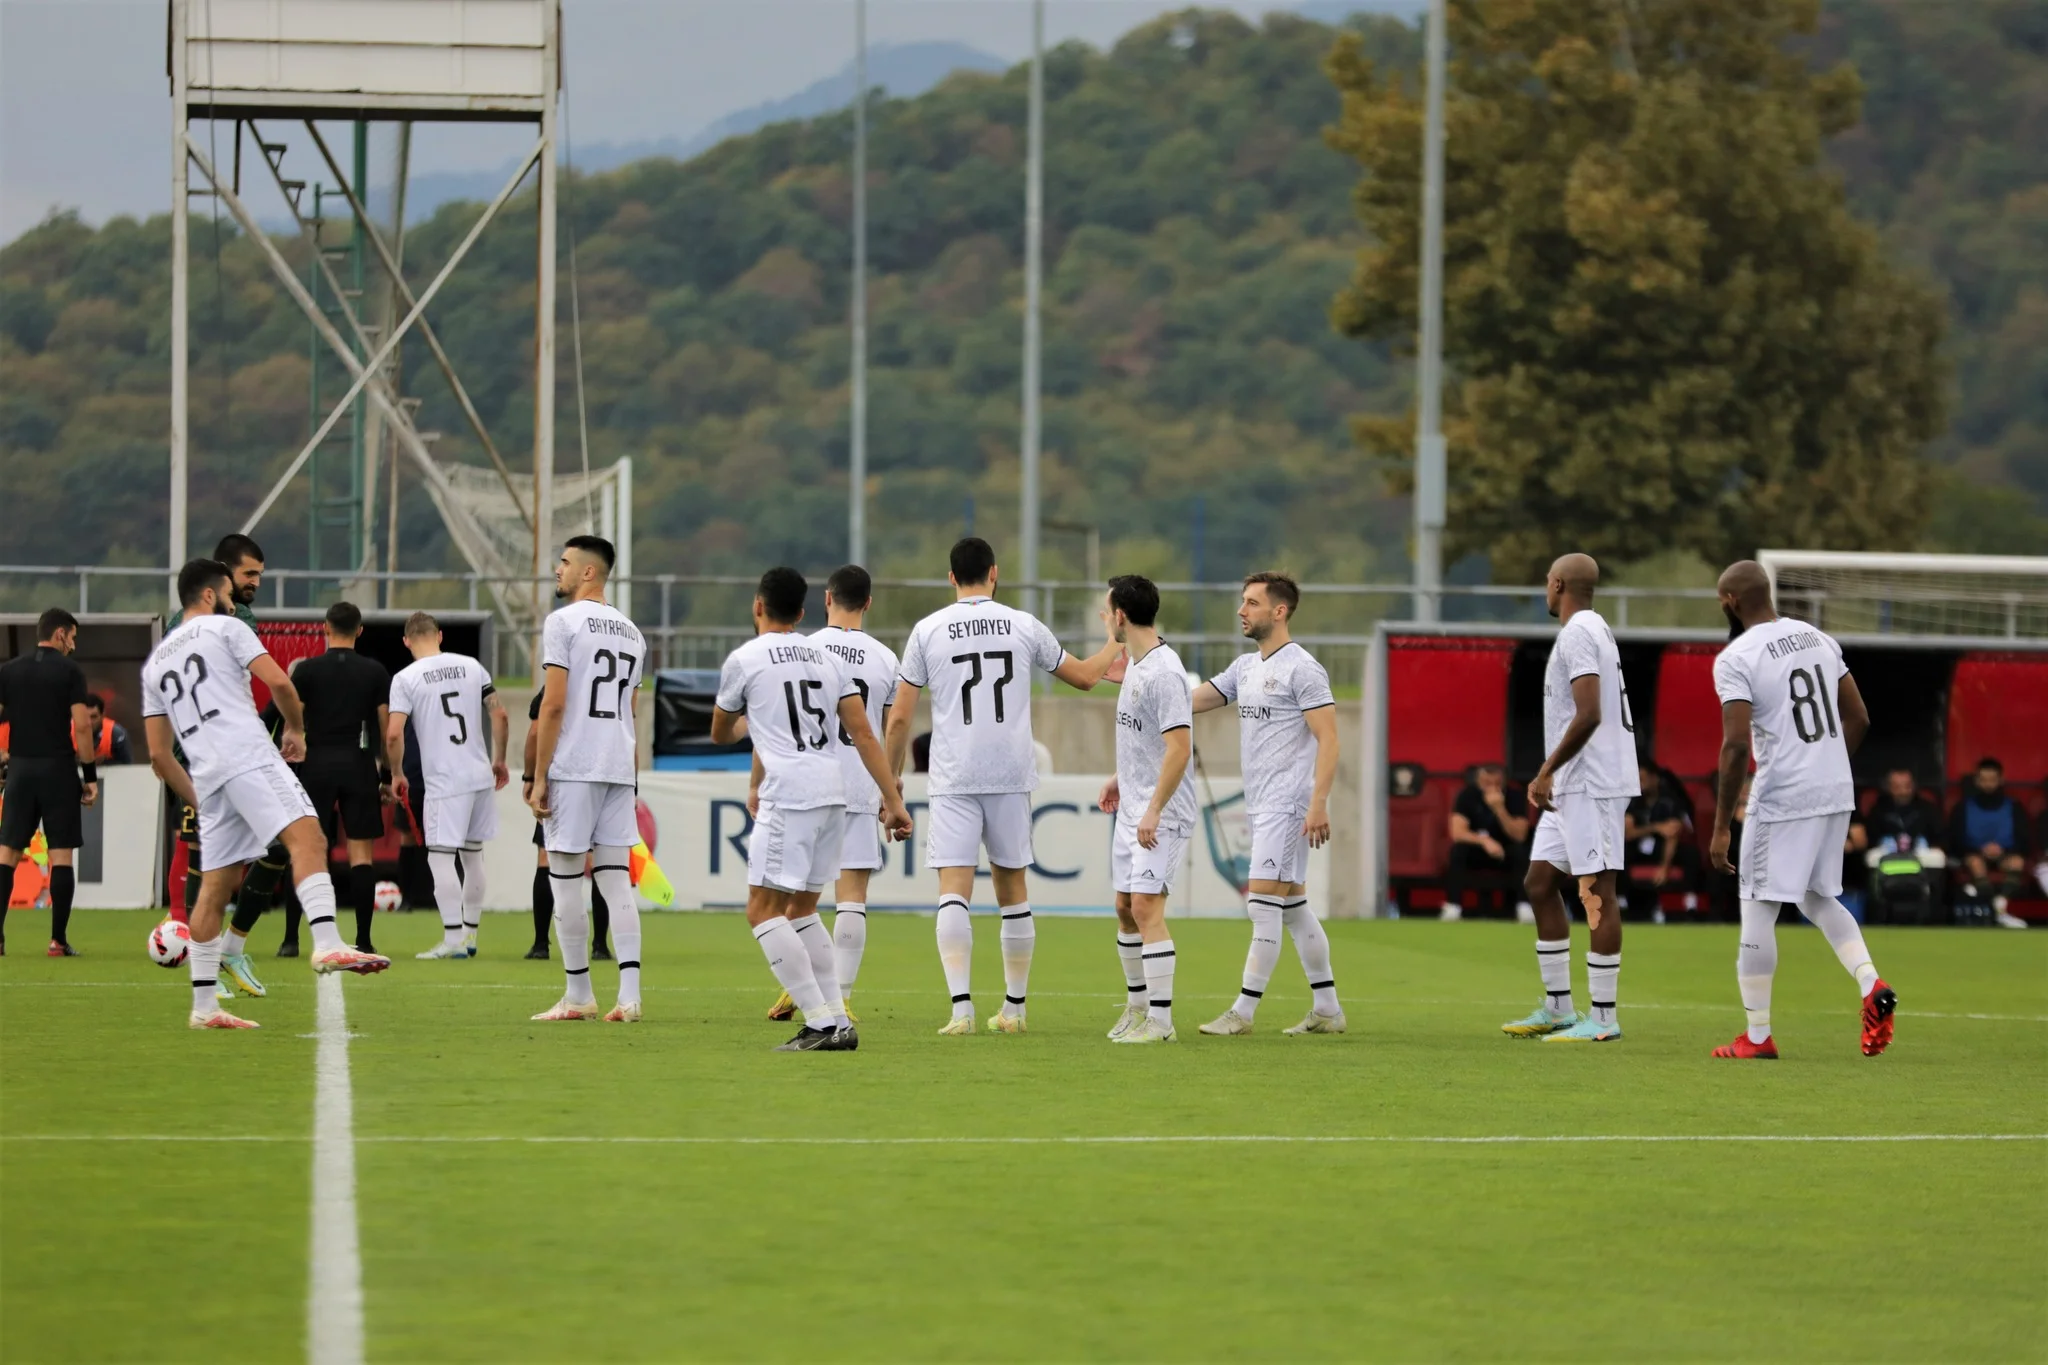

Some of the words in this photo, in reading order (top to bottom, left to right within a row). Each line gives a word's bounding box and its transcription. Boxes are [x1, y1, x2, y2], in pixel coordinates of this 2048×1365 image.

[588, 648, 638, 721] 27
[767, 645, 824, 665] LEANDRO
[951, 650, 1014, 725] 77
[160, 652, 221, 740] 22
[440, 691, 468, 745] 5
[783, 679, 829, 752] 15
[1789, 663, 1838, 744] 81
